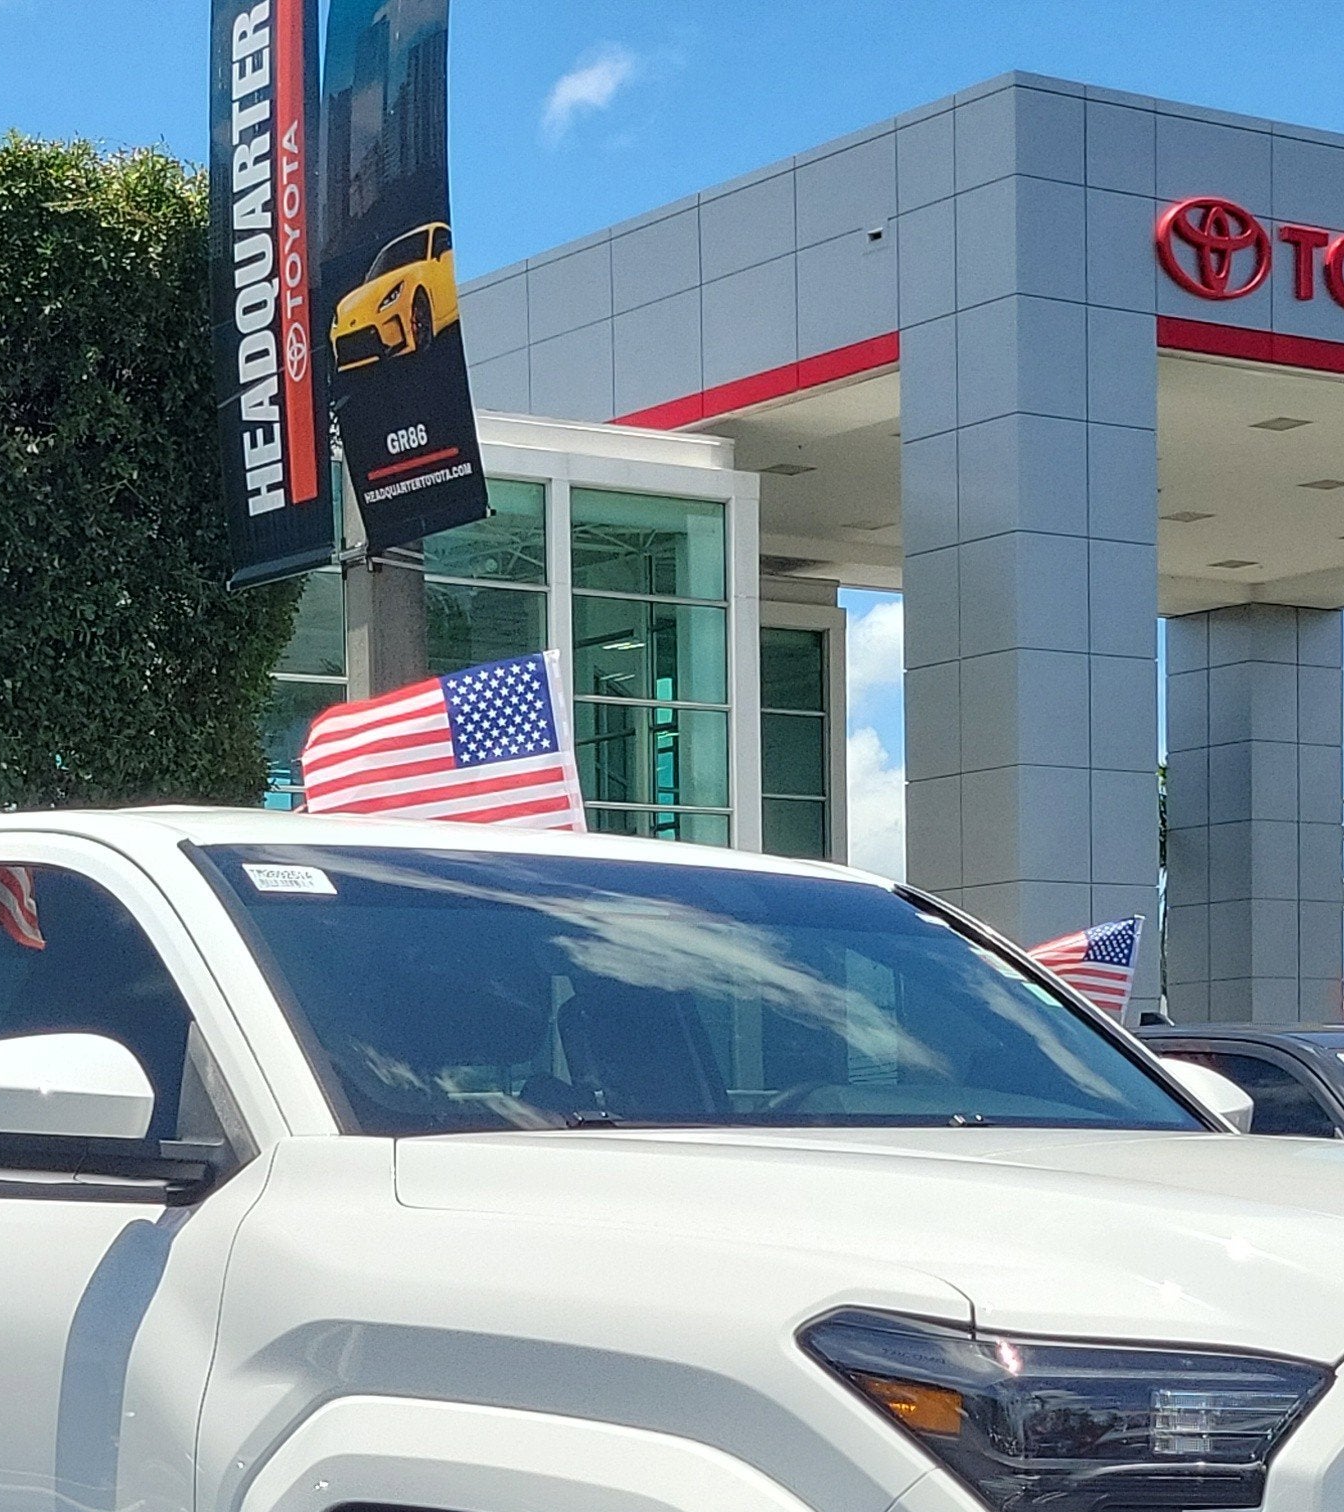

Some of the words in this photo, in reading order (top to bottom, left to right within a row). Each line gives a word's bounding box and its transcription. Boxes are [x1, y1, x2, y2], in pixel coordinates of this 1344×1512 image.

[232, 0, 286, 517] HEADQUARTER
[282, 120, 307, 311] TOYOTA
[363, 462, 473, 504] HEADQUARTERTOYOTA.COM
[386, 423, 428, 455] GR86
